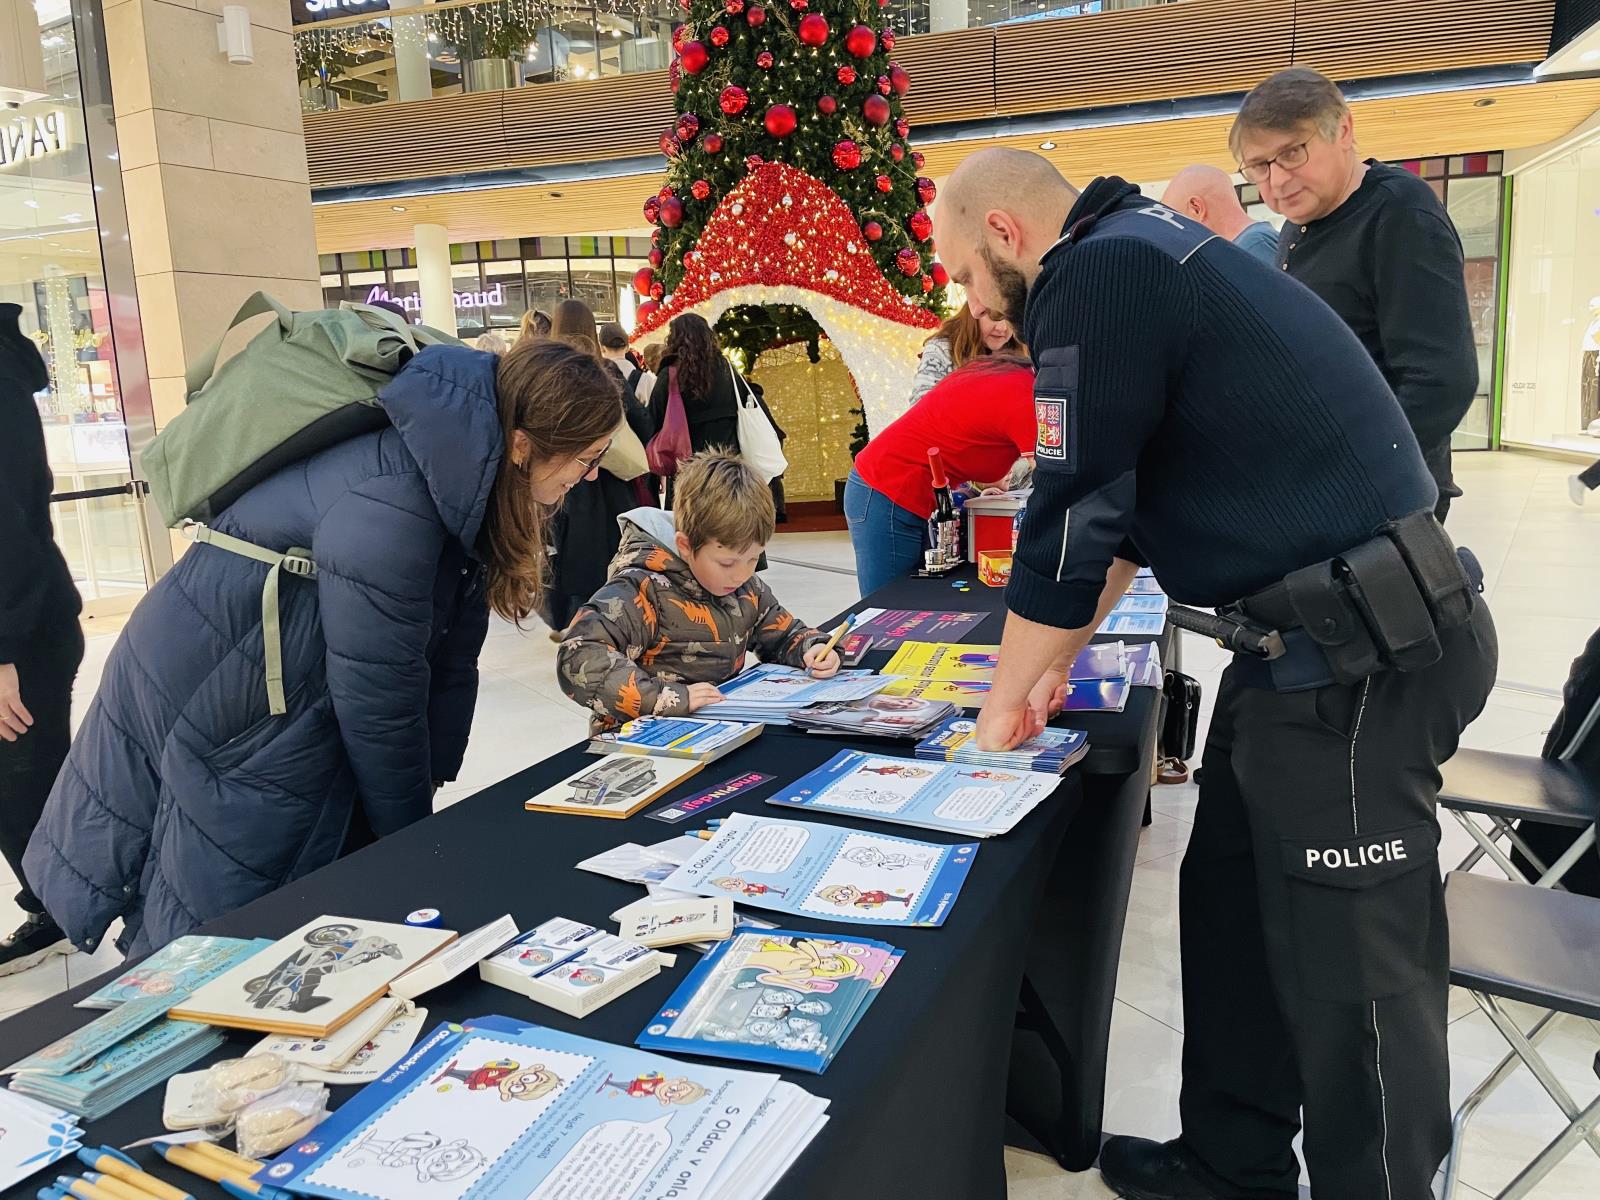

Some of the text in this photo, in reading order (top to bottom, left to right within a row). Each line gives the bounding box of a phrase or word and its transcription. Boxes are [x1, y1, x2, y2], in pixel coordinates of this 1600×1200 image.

[1037, 445, 1063, 456] POLICIE
[681, 773, 763, 811] #nePINdej!
[1306, 839, 1407, 868] POLICIE
[398, 1030, 451, 1072] Olomoucký
[657, 1106, 740, 1200] S Oldou v onla
